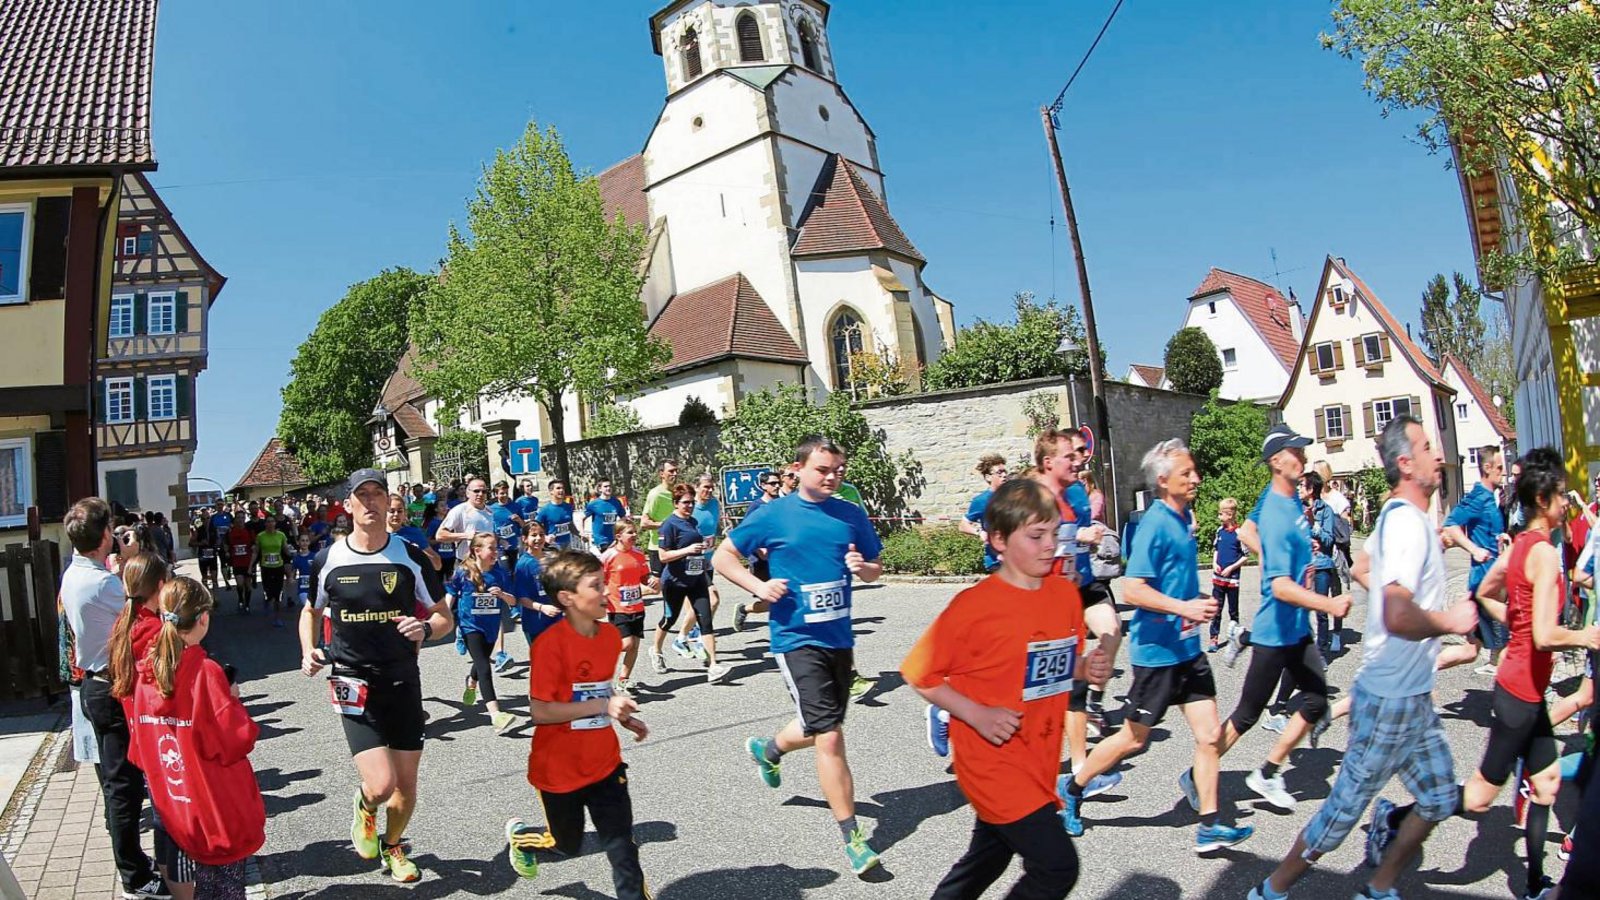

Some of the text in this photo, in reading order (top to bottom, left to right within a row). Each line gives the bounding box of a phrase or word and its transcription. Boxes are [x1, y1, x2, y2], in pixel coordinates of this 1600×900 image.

[477, 598, 495, 606] 224
[815, 592, 841, 608] 220
[340, 609, 401, 623] Ensinger
[1036, 653, 1067, 679] 249
